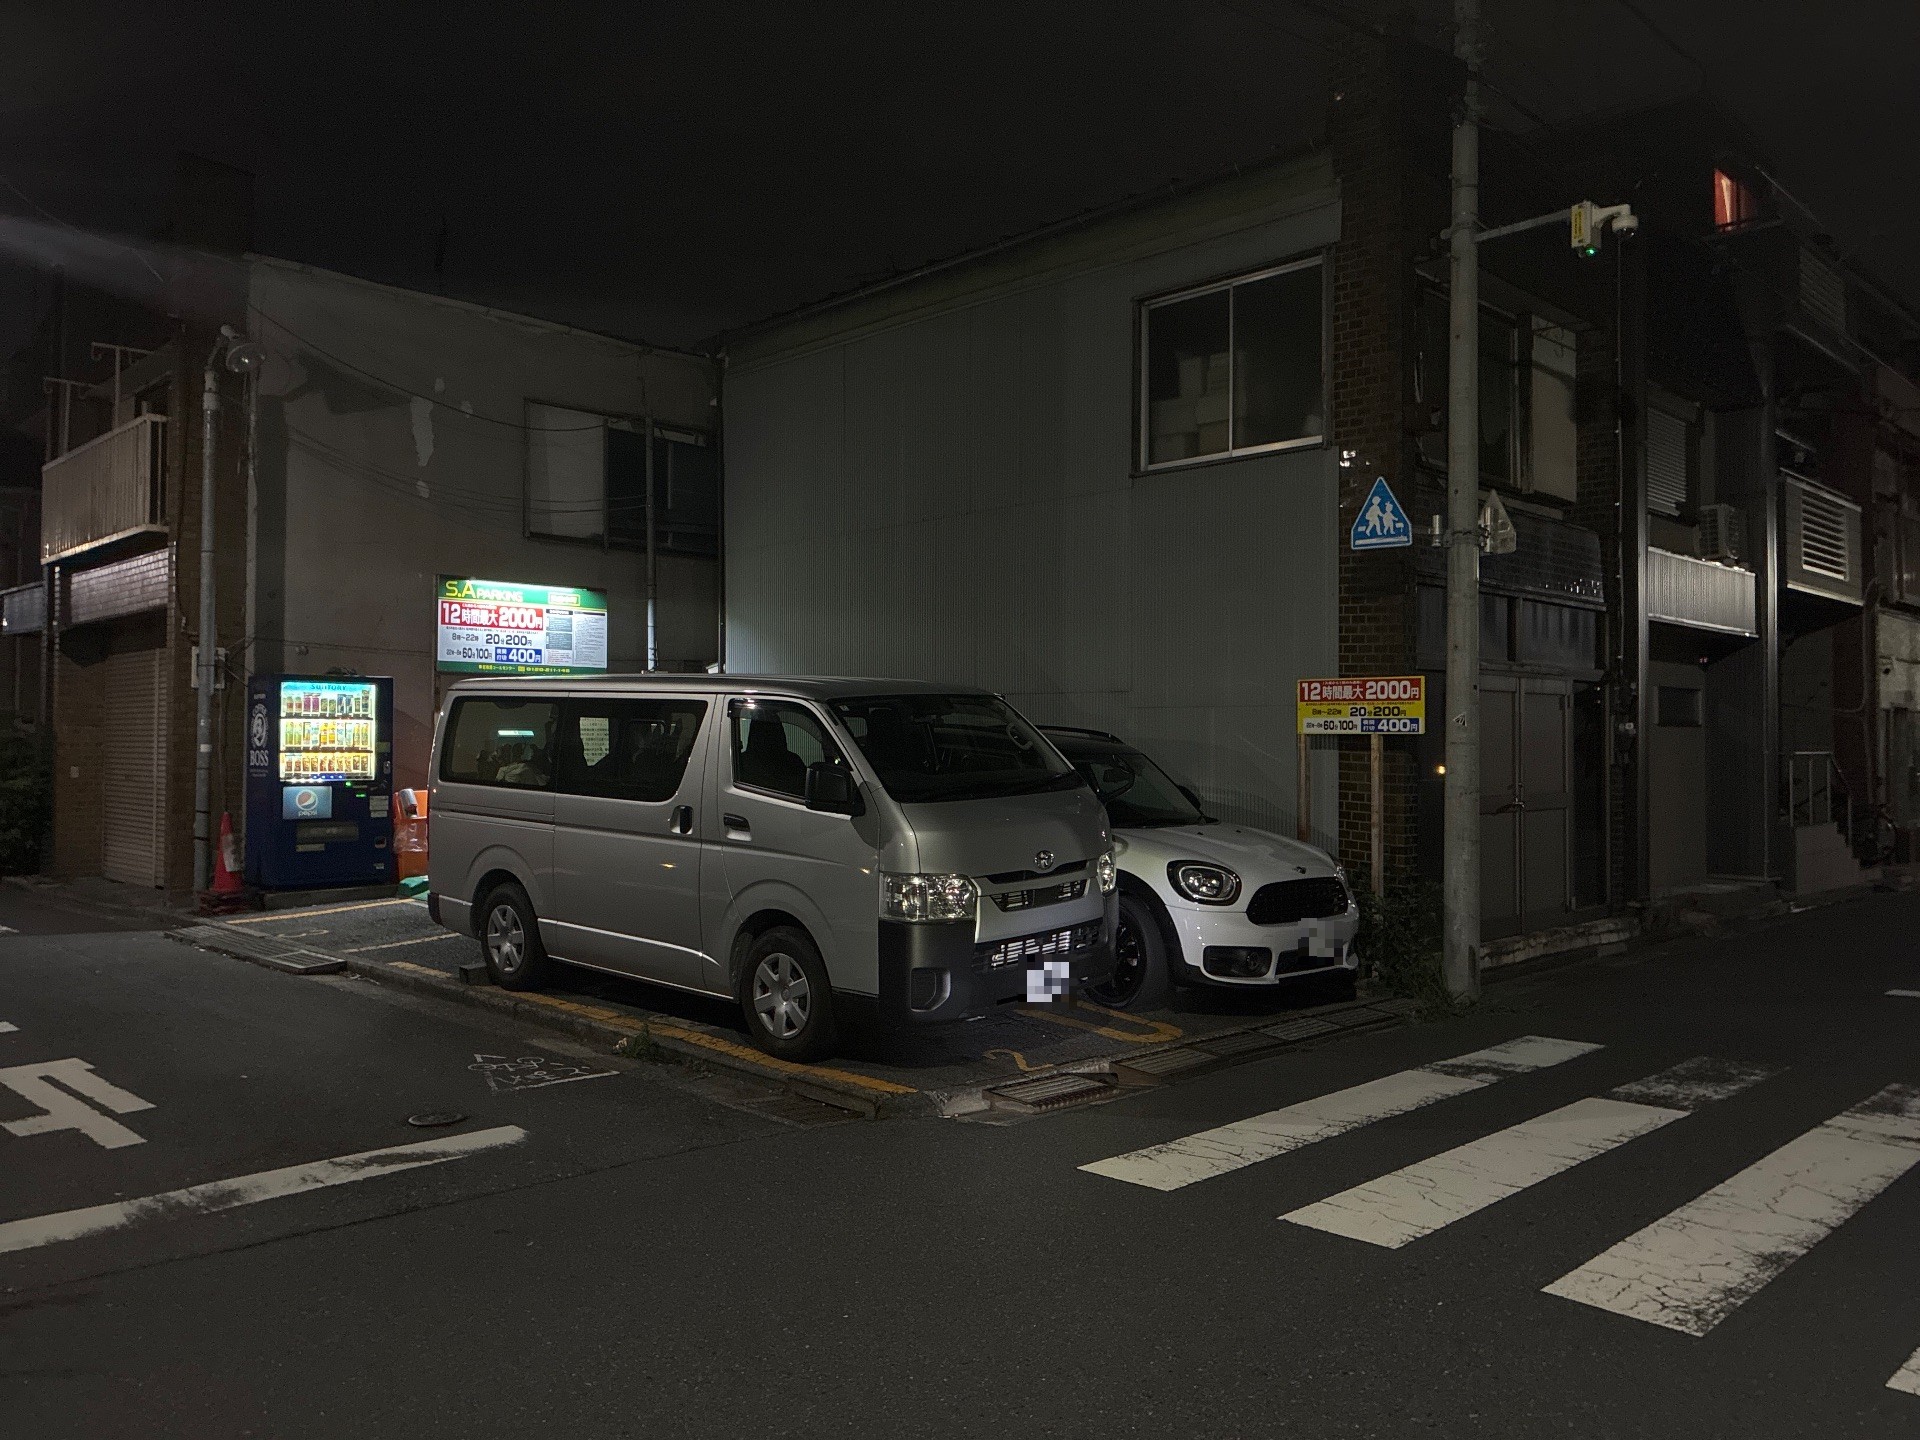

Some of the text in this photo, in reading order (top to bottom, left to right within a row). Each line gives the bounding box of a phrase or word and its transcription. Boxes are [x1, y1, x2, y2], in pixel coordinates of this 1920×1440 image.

[445, 580, 476, 598] S.A
[1377, 719, 1418, 731] 400円
[250, 749, 269, 766] BOSS
